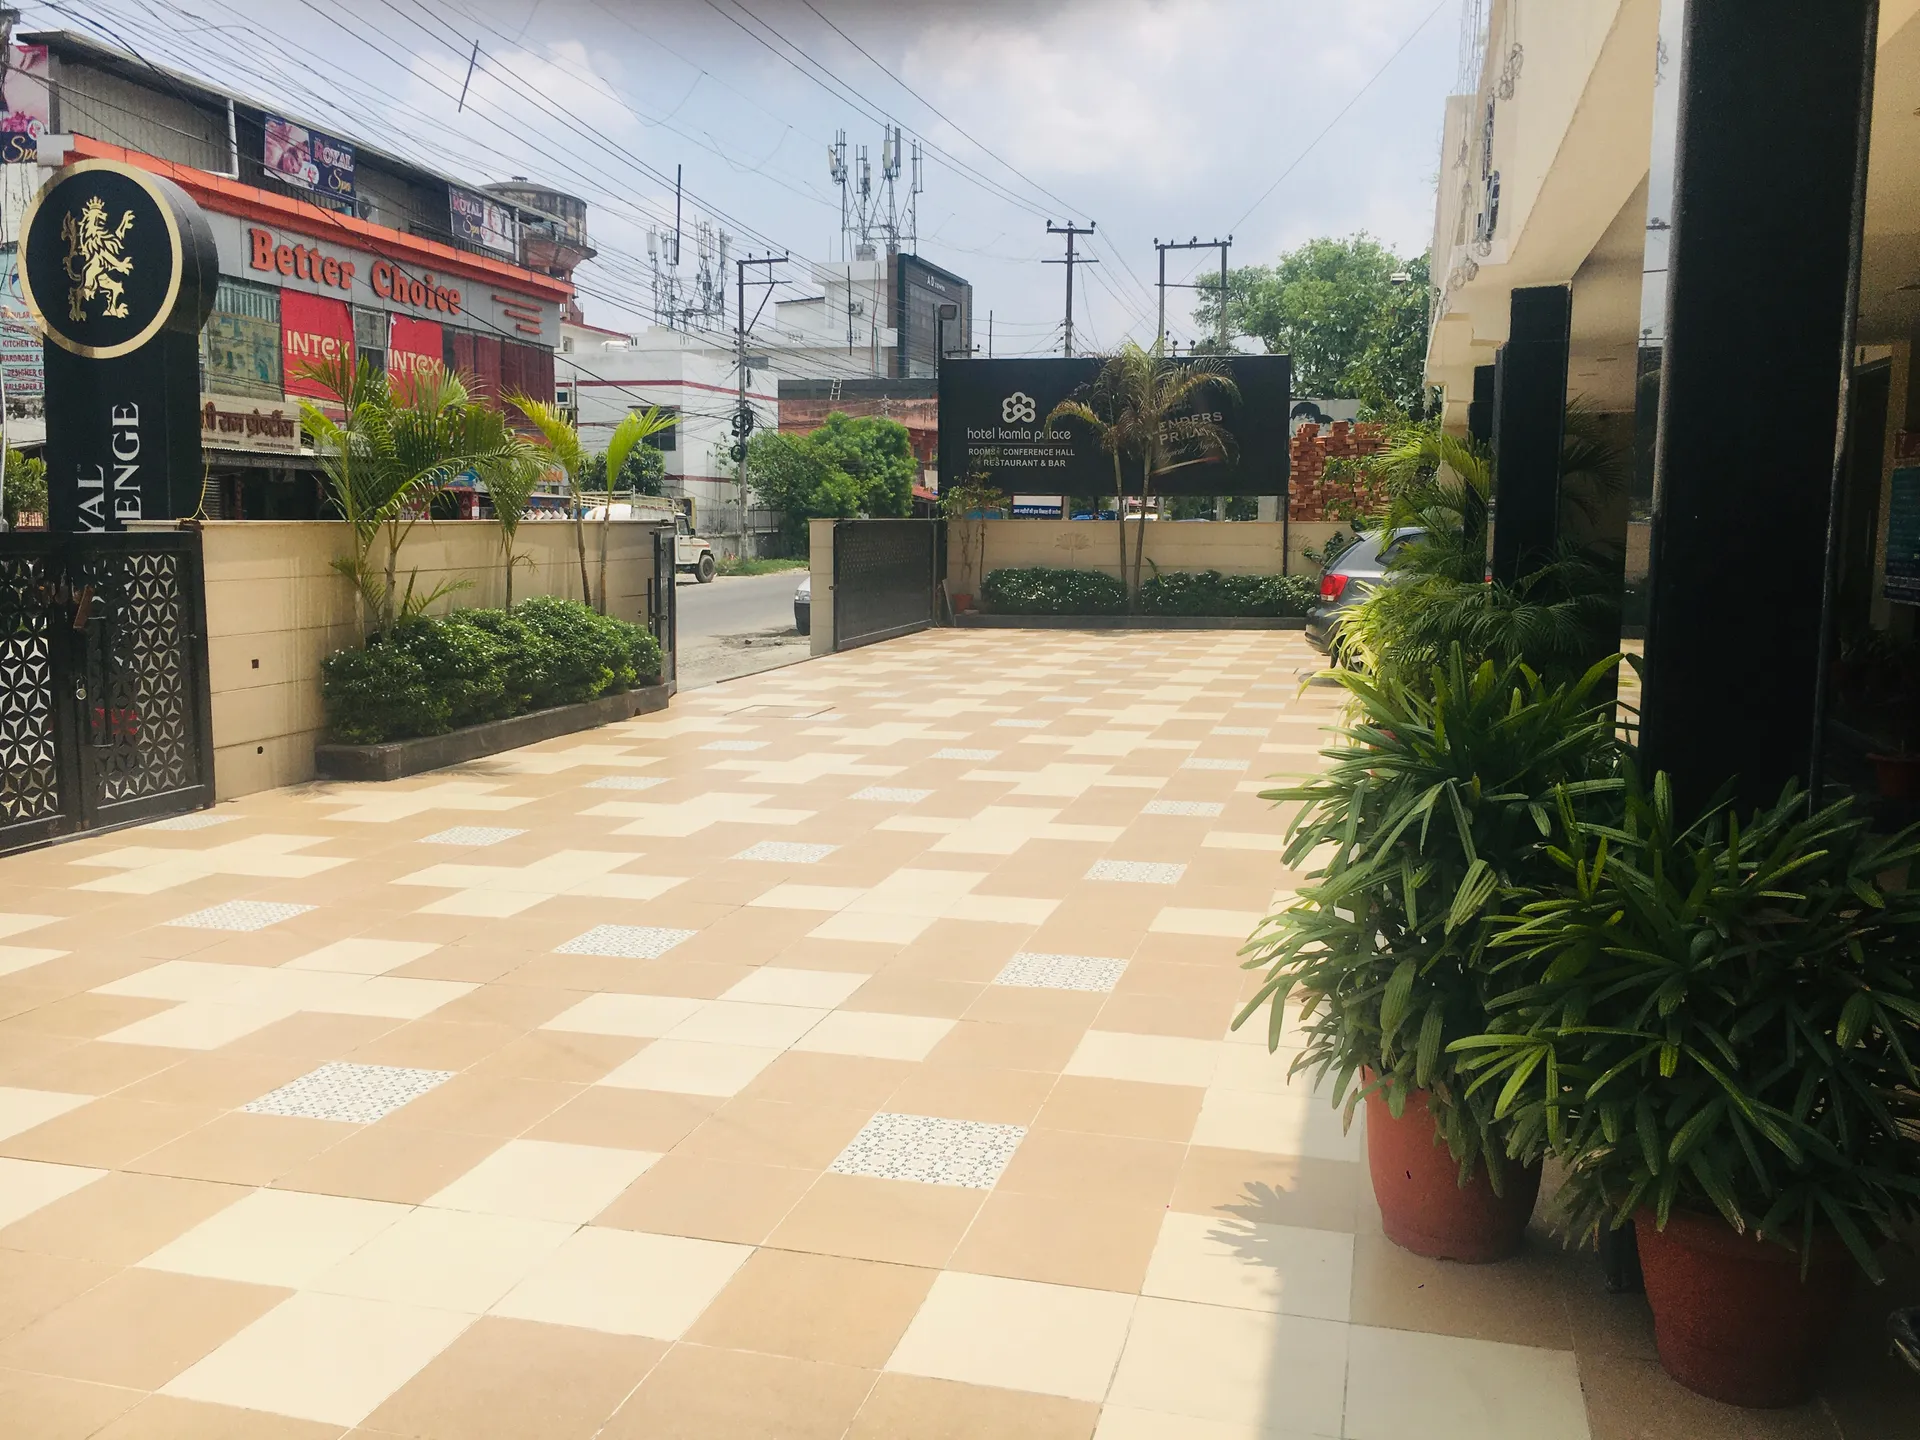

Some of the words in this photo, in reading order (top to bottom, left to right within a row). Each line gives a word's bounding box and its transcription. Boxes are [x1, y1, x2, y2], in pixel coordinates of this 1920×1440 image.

[314, 139, 354, 172] ROYAL
[328, 168, 352, 194] Spa
[452, 192, 482, 217] ROYAL
[463, 215, 480, 239] Spa
[249, 228, 355, 290] Better
[371, 260, 461, 315] Choice
[3, 340, 29, 349] KITCHEN
[967, 427, 995, 439] hotel
[998, 427, 1031, 439] kamla
[983, 459, 1038, 467] RESTAURANT
[1040, 459, 1046, 467] &
[1048, 459, 1066, 467] BAR
[1003, 448, 1053, 456] CONFERENCE
[1055, 448, 1075, 456] HALL
